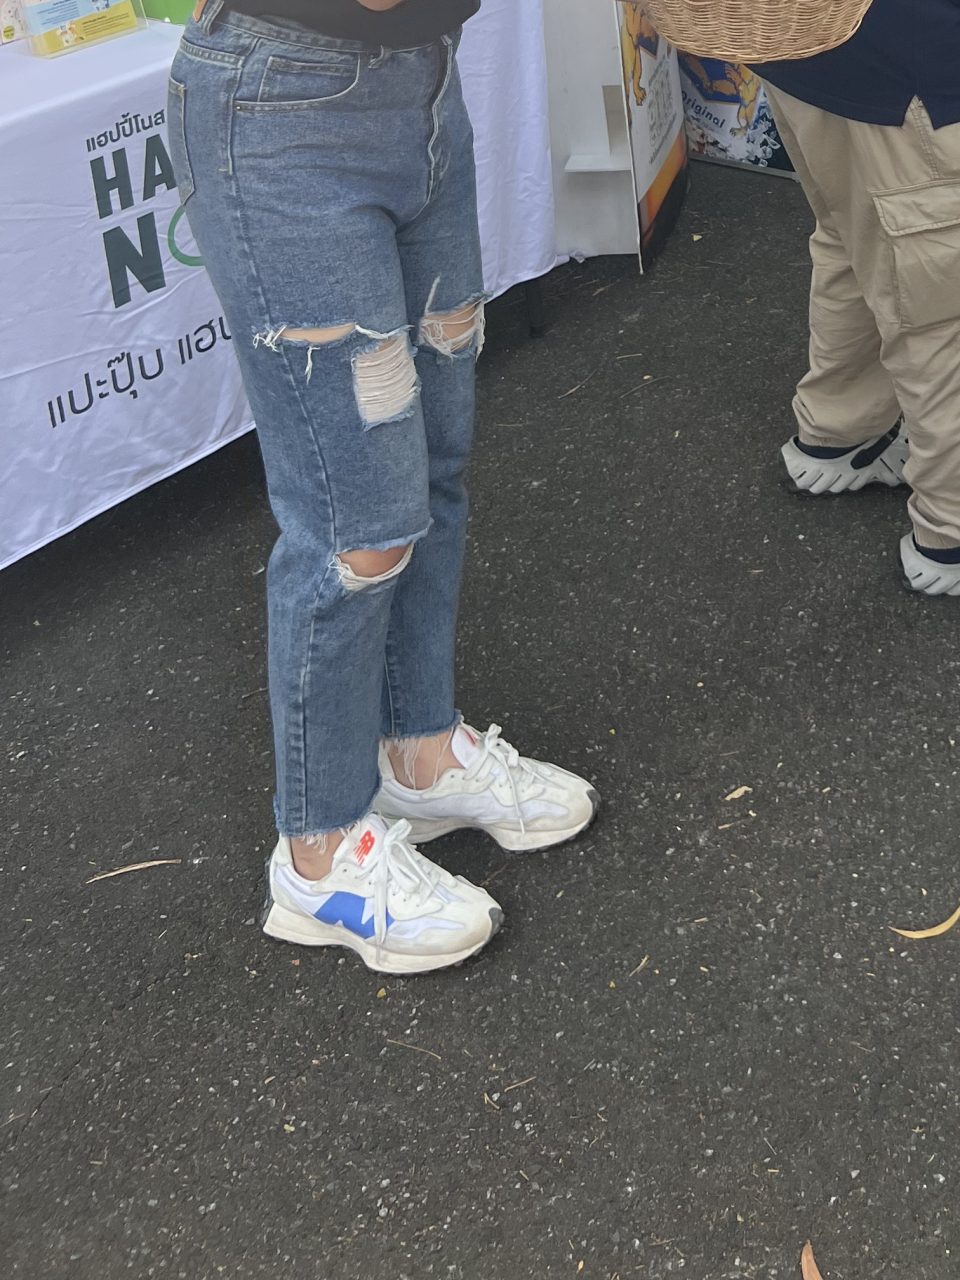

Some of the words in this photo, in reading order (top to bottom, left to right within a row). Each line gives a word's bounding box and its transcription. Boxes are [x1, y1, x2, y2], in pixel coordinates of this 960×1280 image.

[86, 109, 166, 153] แฮปปี้โนส
[89, 133, 178, 220] HA
[48, 348, 164, 429] แปะปุ๊บ
